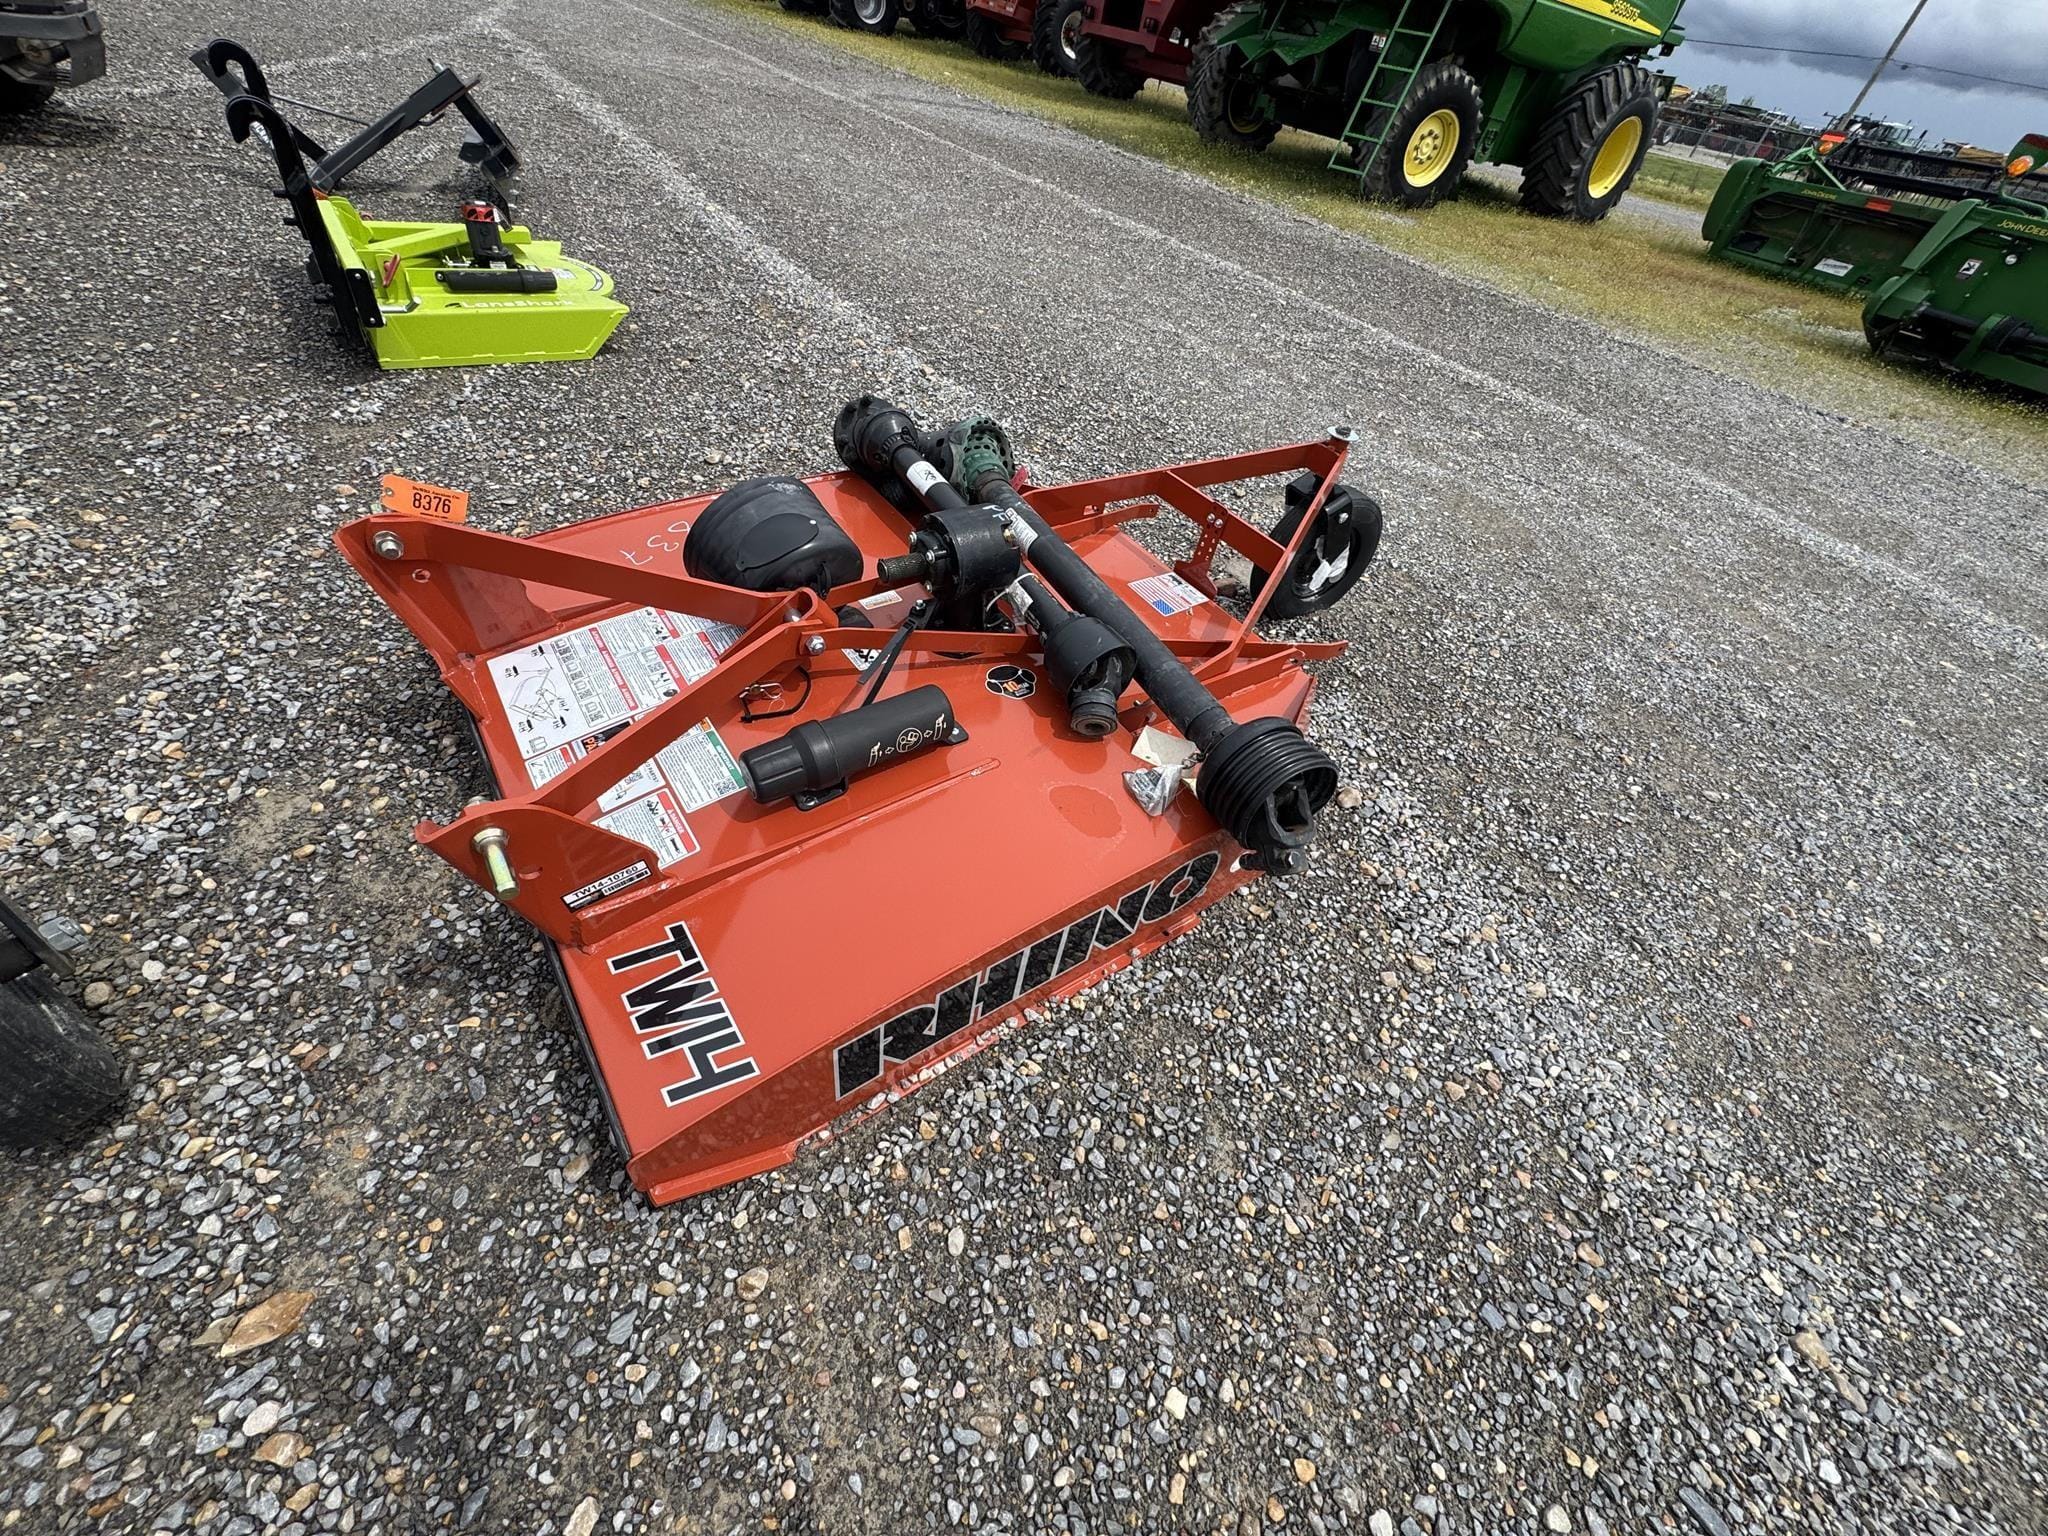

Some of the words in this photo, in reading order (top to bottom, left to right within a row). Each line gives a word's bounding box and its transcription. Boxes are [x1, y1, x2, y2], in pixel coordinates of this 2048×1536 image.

[1997, 219, 2026, 232] JOHN
[2025, 224, 2048, 237] DEE
[461, 300, 572, 308] LaneShark
[412, 492, 452, 514] 8376
[669, 812, 684, 834] DANGER
[572, 866, 638, 898] TW14-10760
[833, 850, 1221, 1101] RHINO
[605, 920, 761, 1108] TWH
